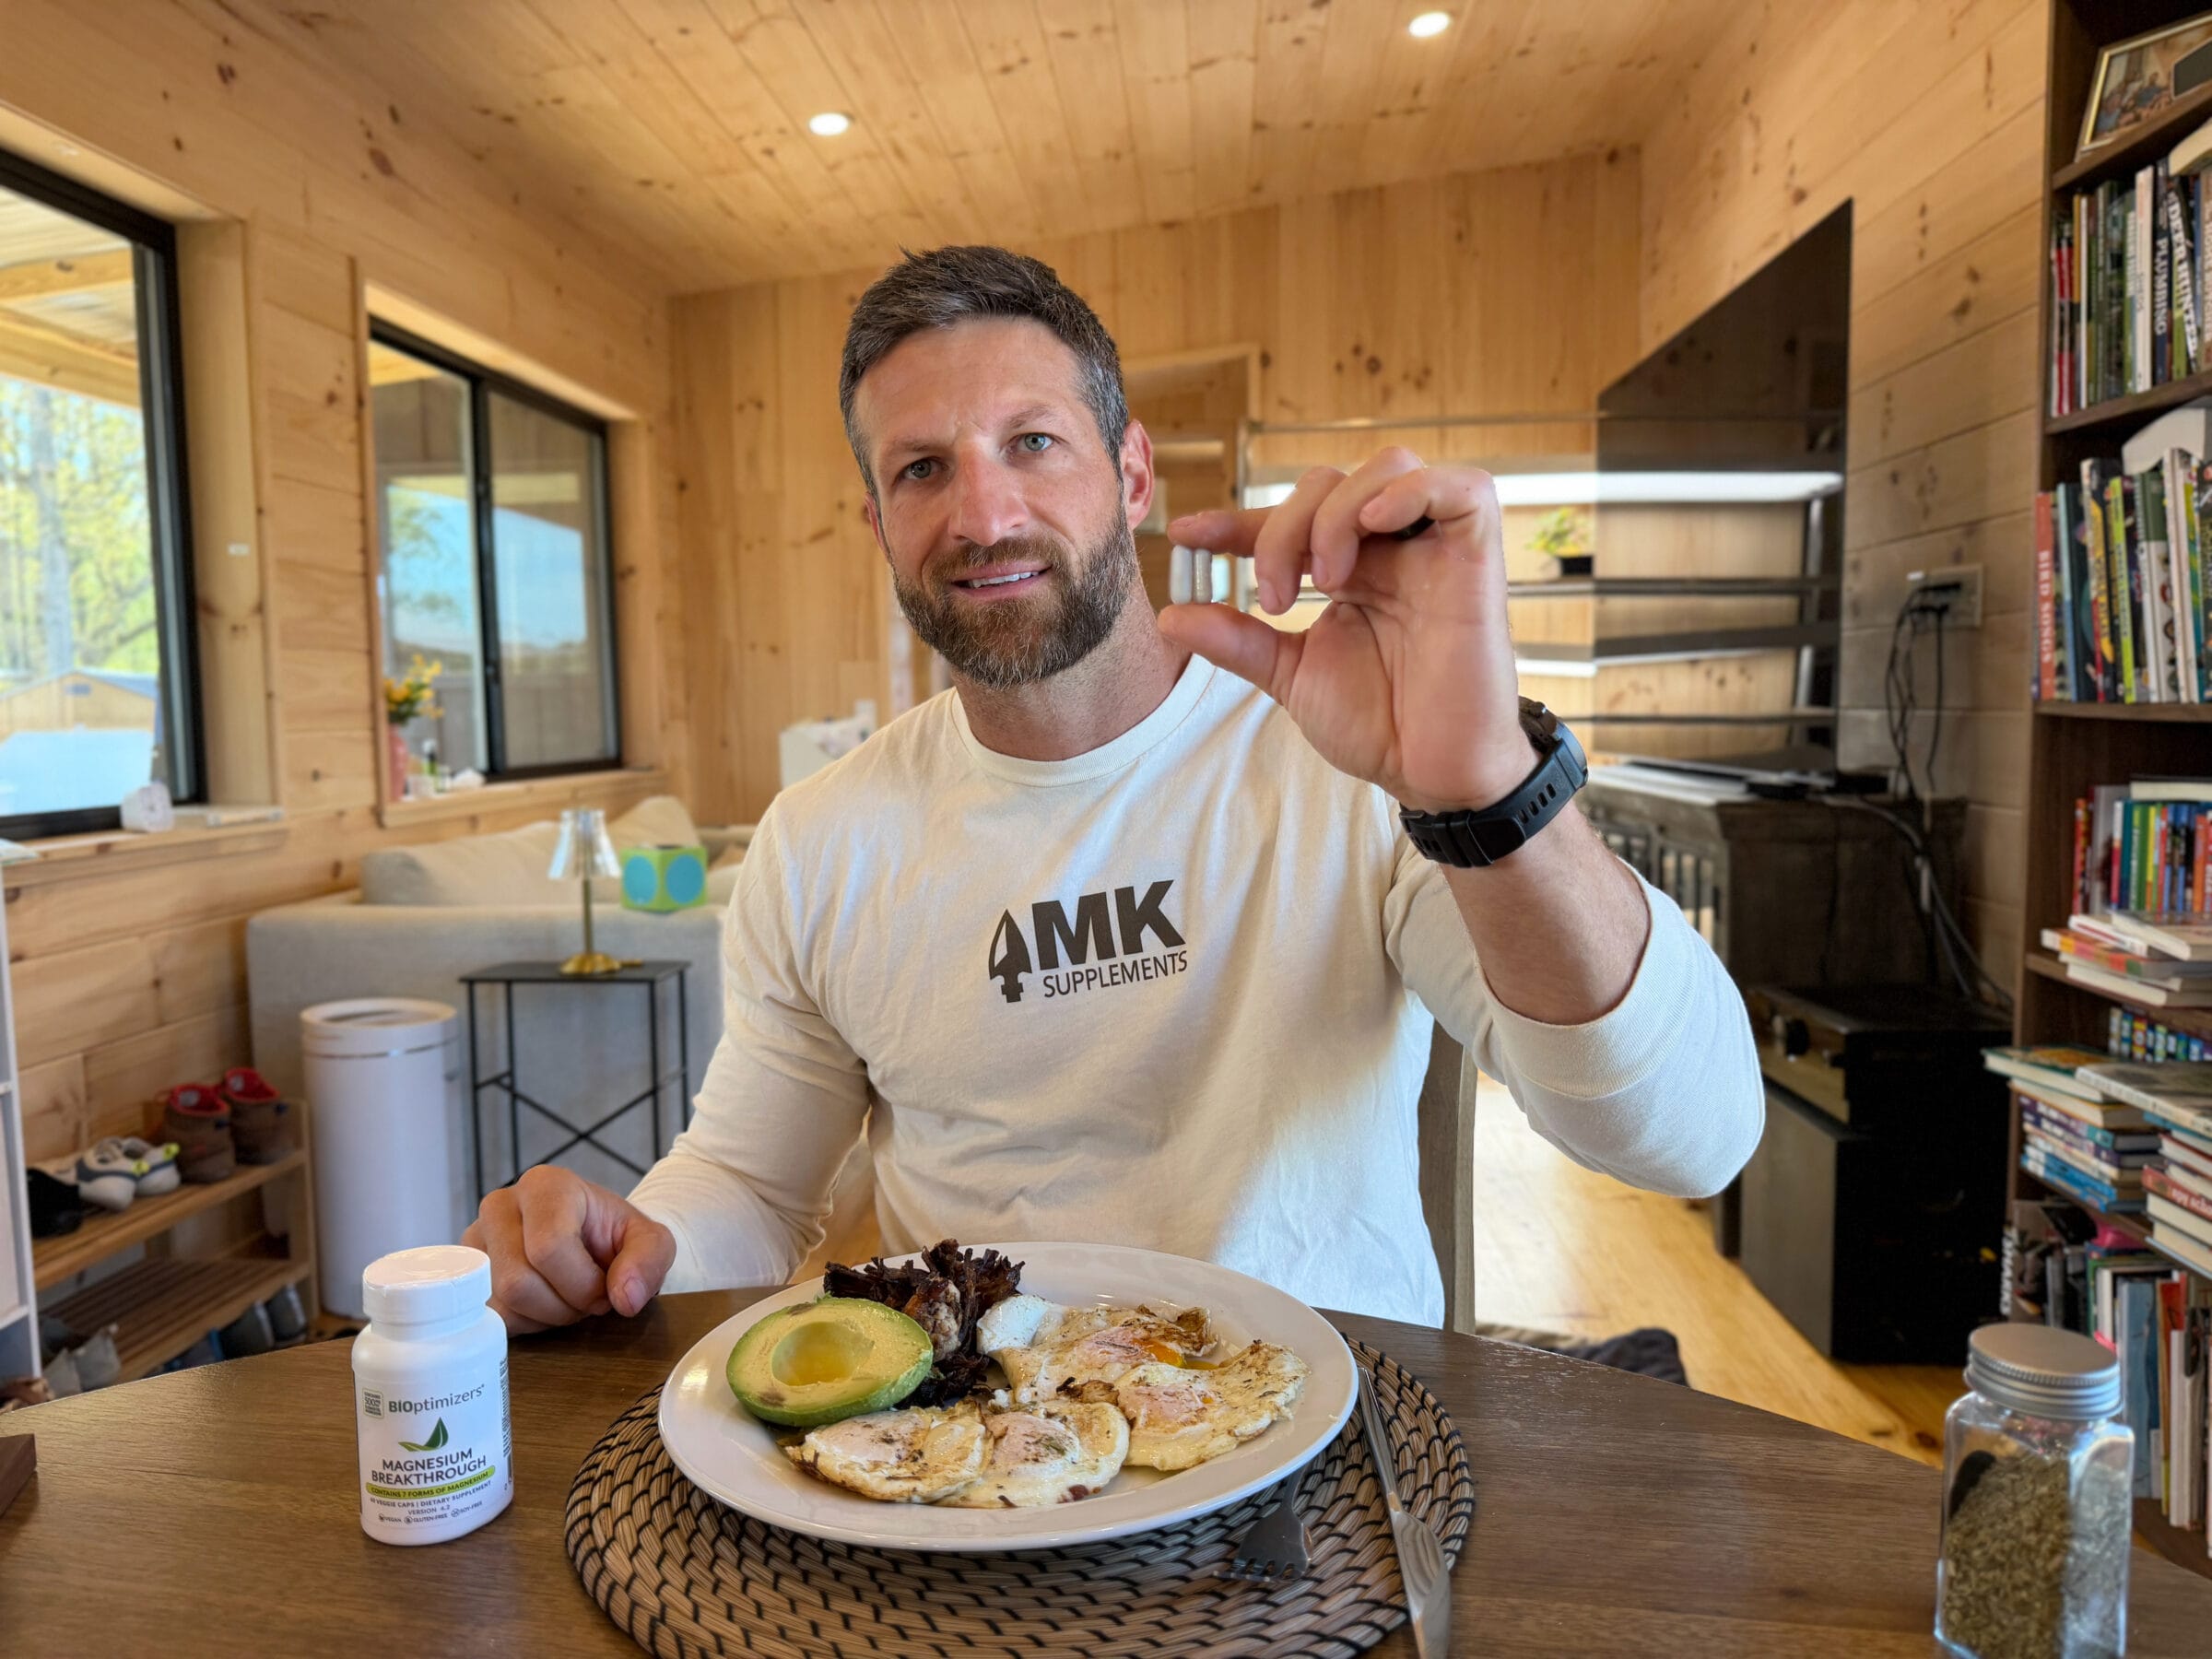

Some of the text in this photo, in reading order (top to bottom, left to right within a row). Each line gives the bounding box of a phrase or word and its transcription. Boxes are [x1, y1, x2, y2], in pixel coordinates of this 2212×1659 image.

[2154, 237, 2169, 336] PLUMBING
[2037, 550, 2053, 664] BIRD SONGS
[1031, 879, 1186, 971] MK
[1043, 950, 1188, 998] SUPPLEMENTS
[371, 1455, 487, 1485] BREAKTHROUGH
[382, 1448, 472, 1472] MAGNESIUM
[371, 1487, 401, 1498] CONTAINS
[407, 1489, 434, 1498] FORMS
[447, 1471, 488, 1492] MAGNESIUM
[376, 1499, 396, 1507] VEGGIE
[420, 1497, 451, 1507] DIETARY
[452, 1480, 491, 1501] SUPPLEMENT
[407, 1507, 437, 1515] VERSION
